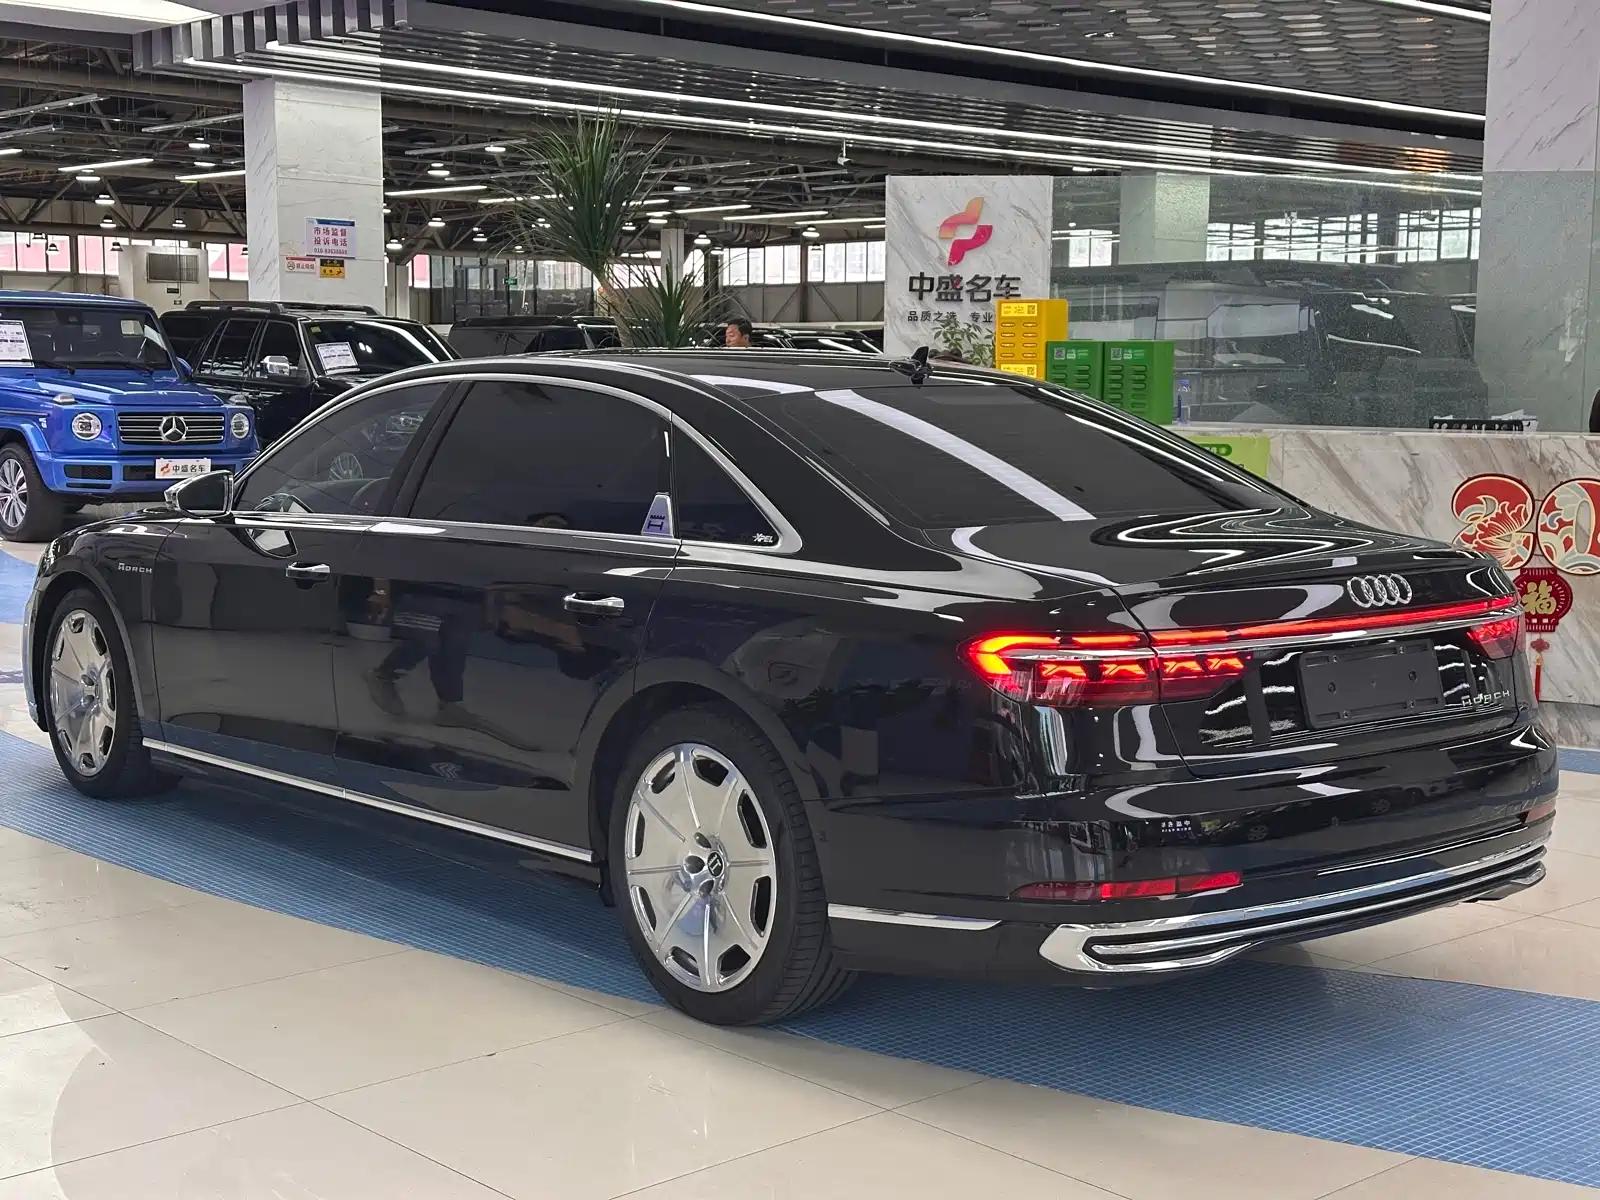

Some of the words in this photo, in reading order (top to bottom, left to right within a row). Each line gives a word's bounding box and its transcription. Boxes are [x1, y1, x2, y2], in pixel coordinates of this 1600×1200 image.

[314, 227, 347, 236] 市场监督
[314, 237, 348, 246] 投诉电话
[908, 271, 1021, 302] 中盛名车
[173, 464, 205, 473] 中盛名车
[1522, 580, 1557, 615] 福
[1461, 690, 1510, 706] HORCH
